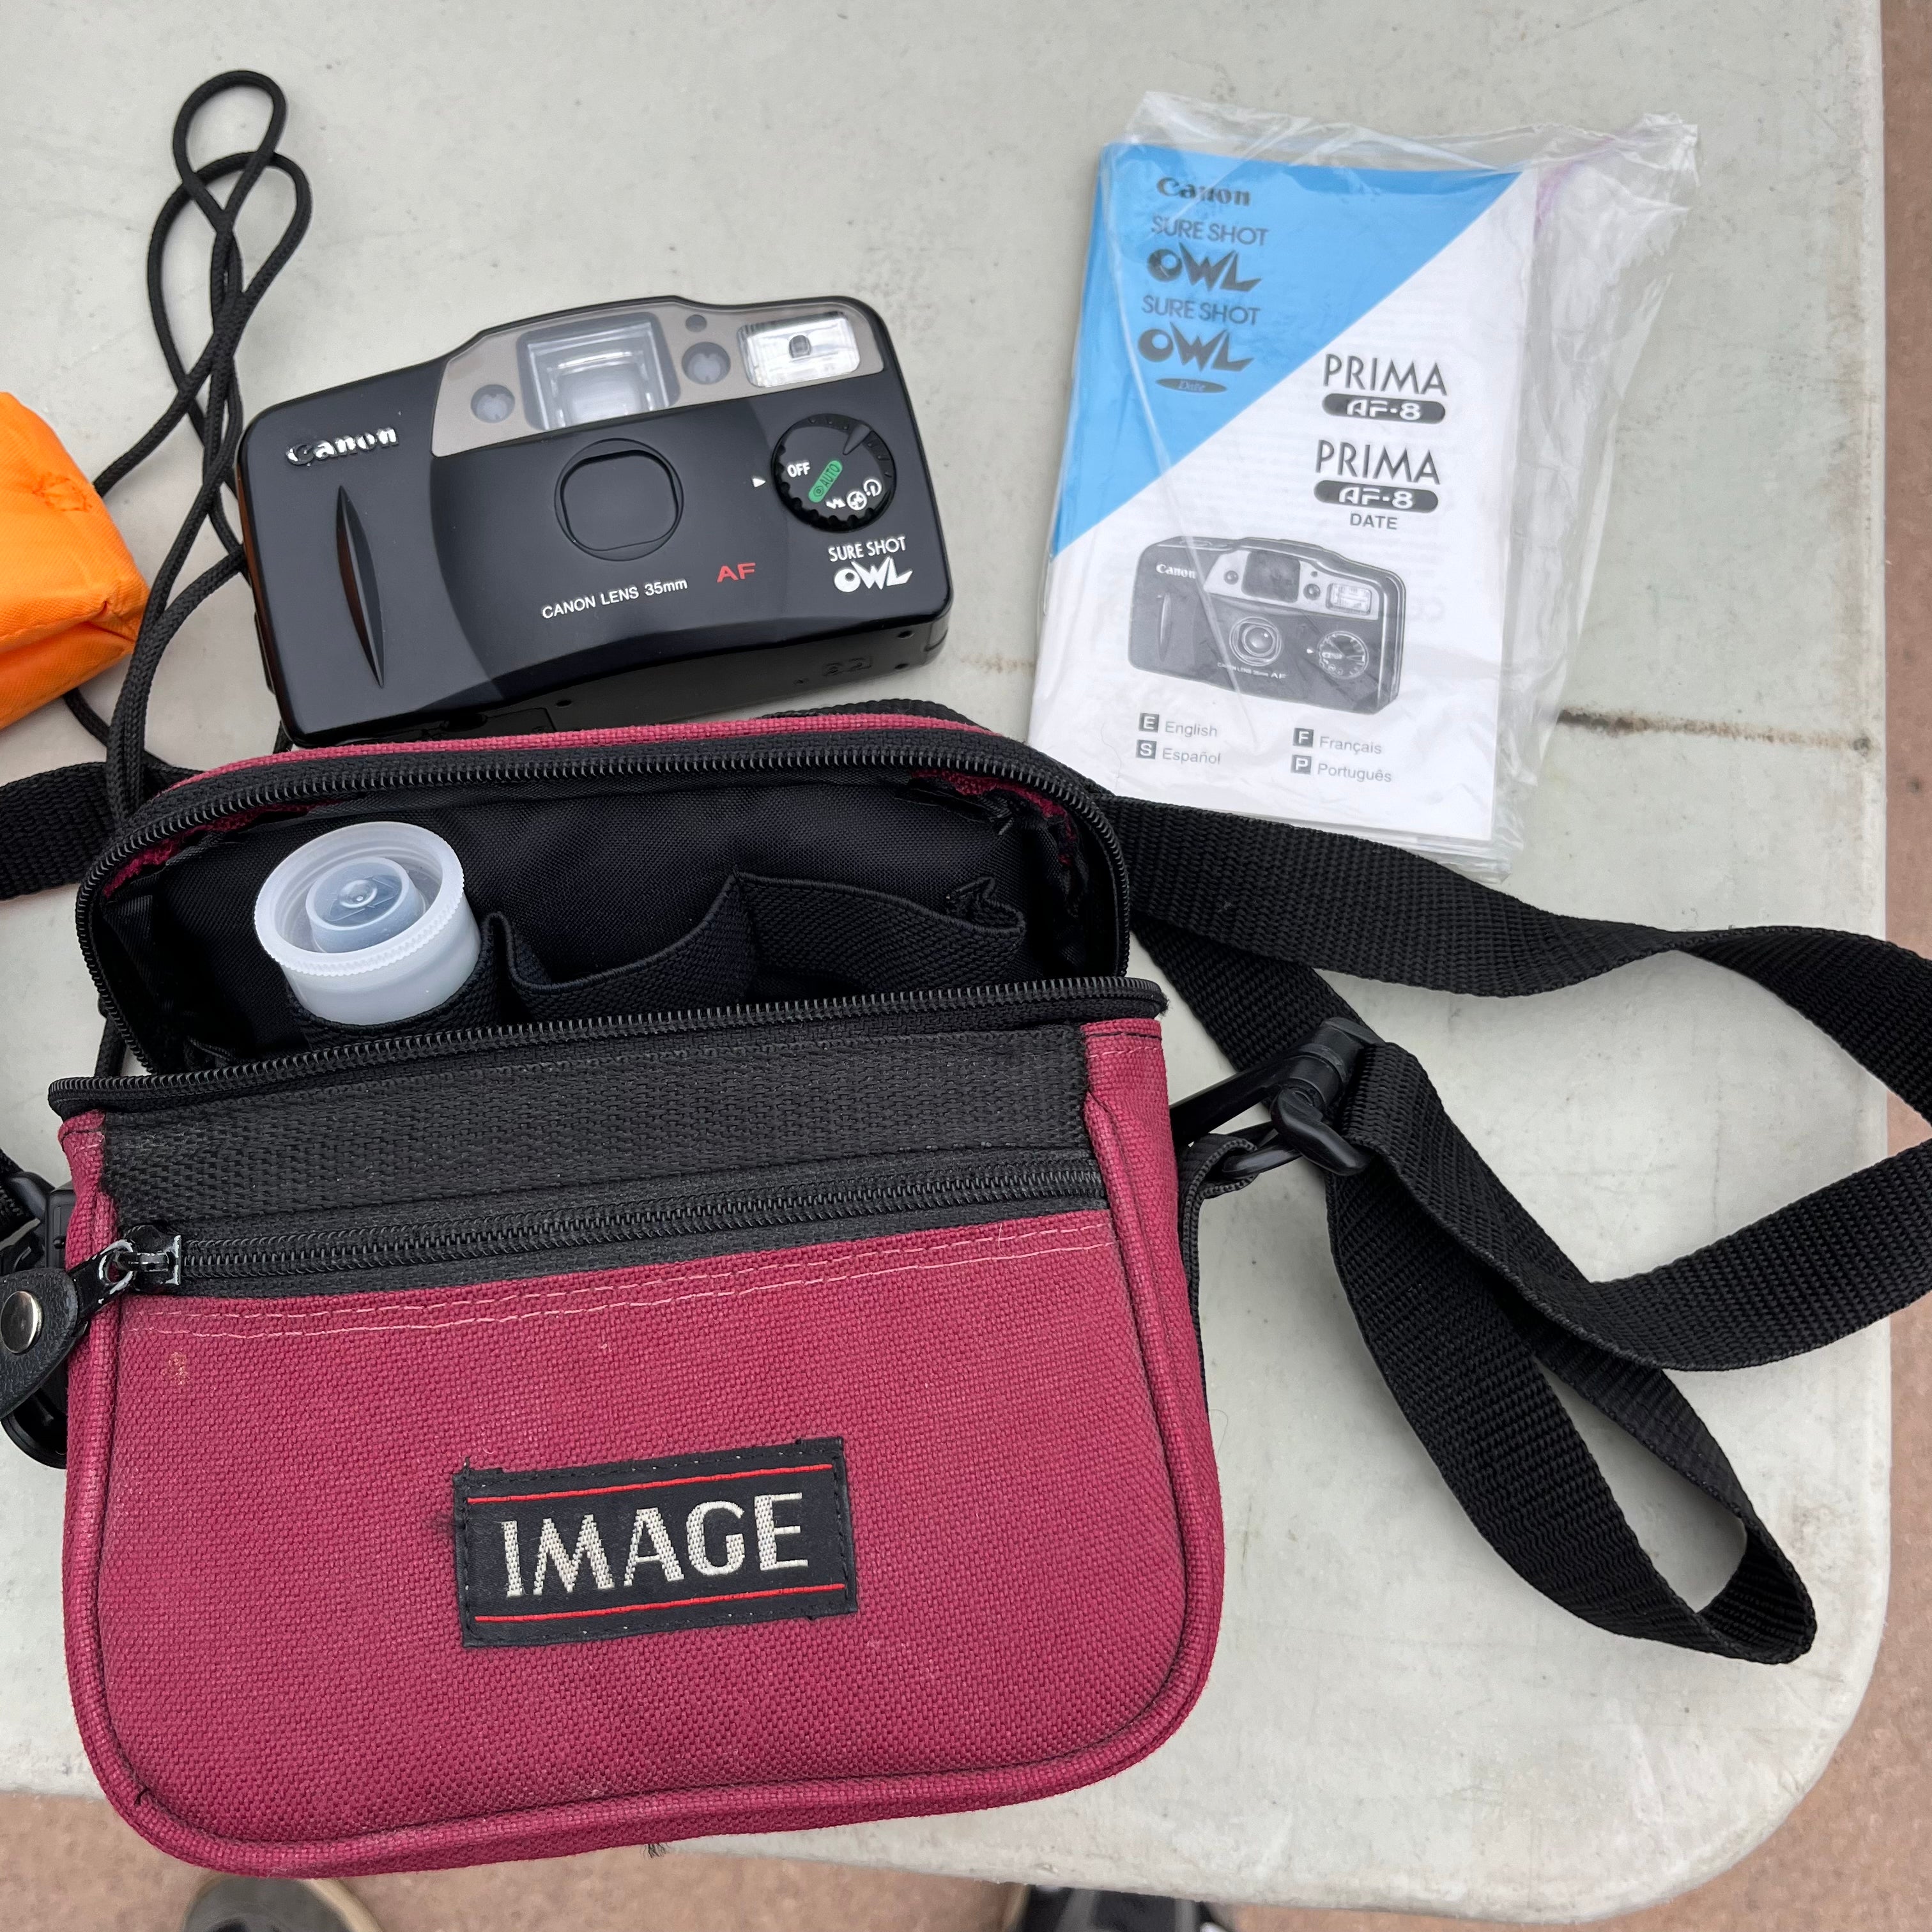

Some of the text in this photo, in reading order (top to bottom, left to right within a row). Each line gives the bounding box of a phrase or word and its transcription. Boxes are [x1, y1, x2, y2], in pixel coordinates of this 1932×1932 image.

[1156, 176, 1250, 206] Canon
[1151, 215, 1269, 246] SURE SHOT
[1147, 241, 1262, 293] OWL
[1142, 295, 1261, 325] SURE SHOT
[1138, 321, 1255, 372] OWL
[1322, 353, 1447, 396] PRIMA
[1346, 399, 1422, 420] AF-8
[286, 427, 399, 466] Canon
[786, 461, 810, 477] OFF
[822, 464, 841, 487] AUTO
[1315, 439, 1441, 485] PRIMA
[1338, 486, 1414, 509] AF-8
[1349, 512, 1398, 530] DATE
[828, 535, 907, 562] SURE SHOT
[716, 562, 756, 583] AF
[834, 556, 913, 593] OWL
[1156, 564, 1196, 579] Canon
[542, 578, 688, 619] CANON LENS 35mm
[1142, 715, 1218, 738] E English
[1139, 742, 1221, 765] S Español
[1298, 730, 1383, 755] F Français
[1295, 757, 1392, 783] P Português
[501, 1492, 809, 1597] IMAGE
